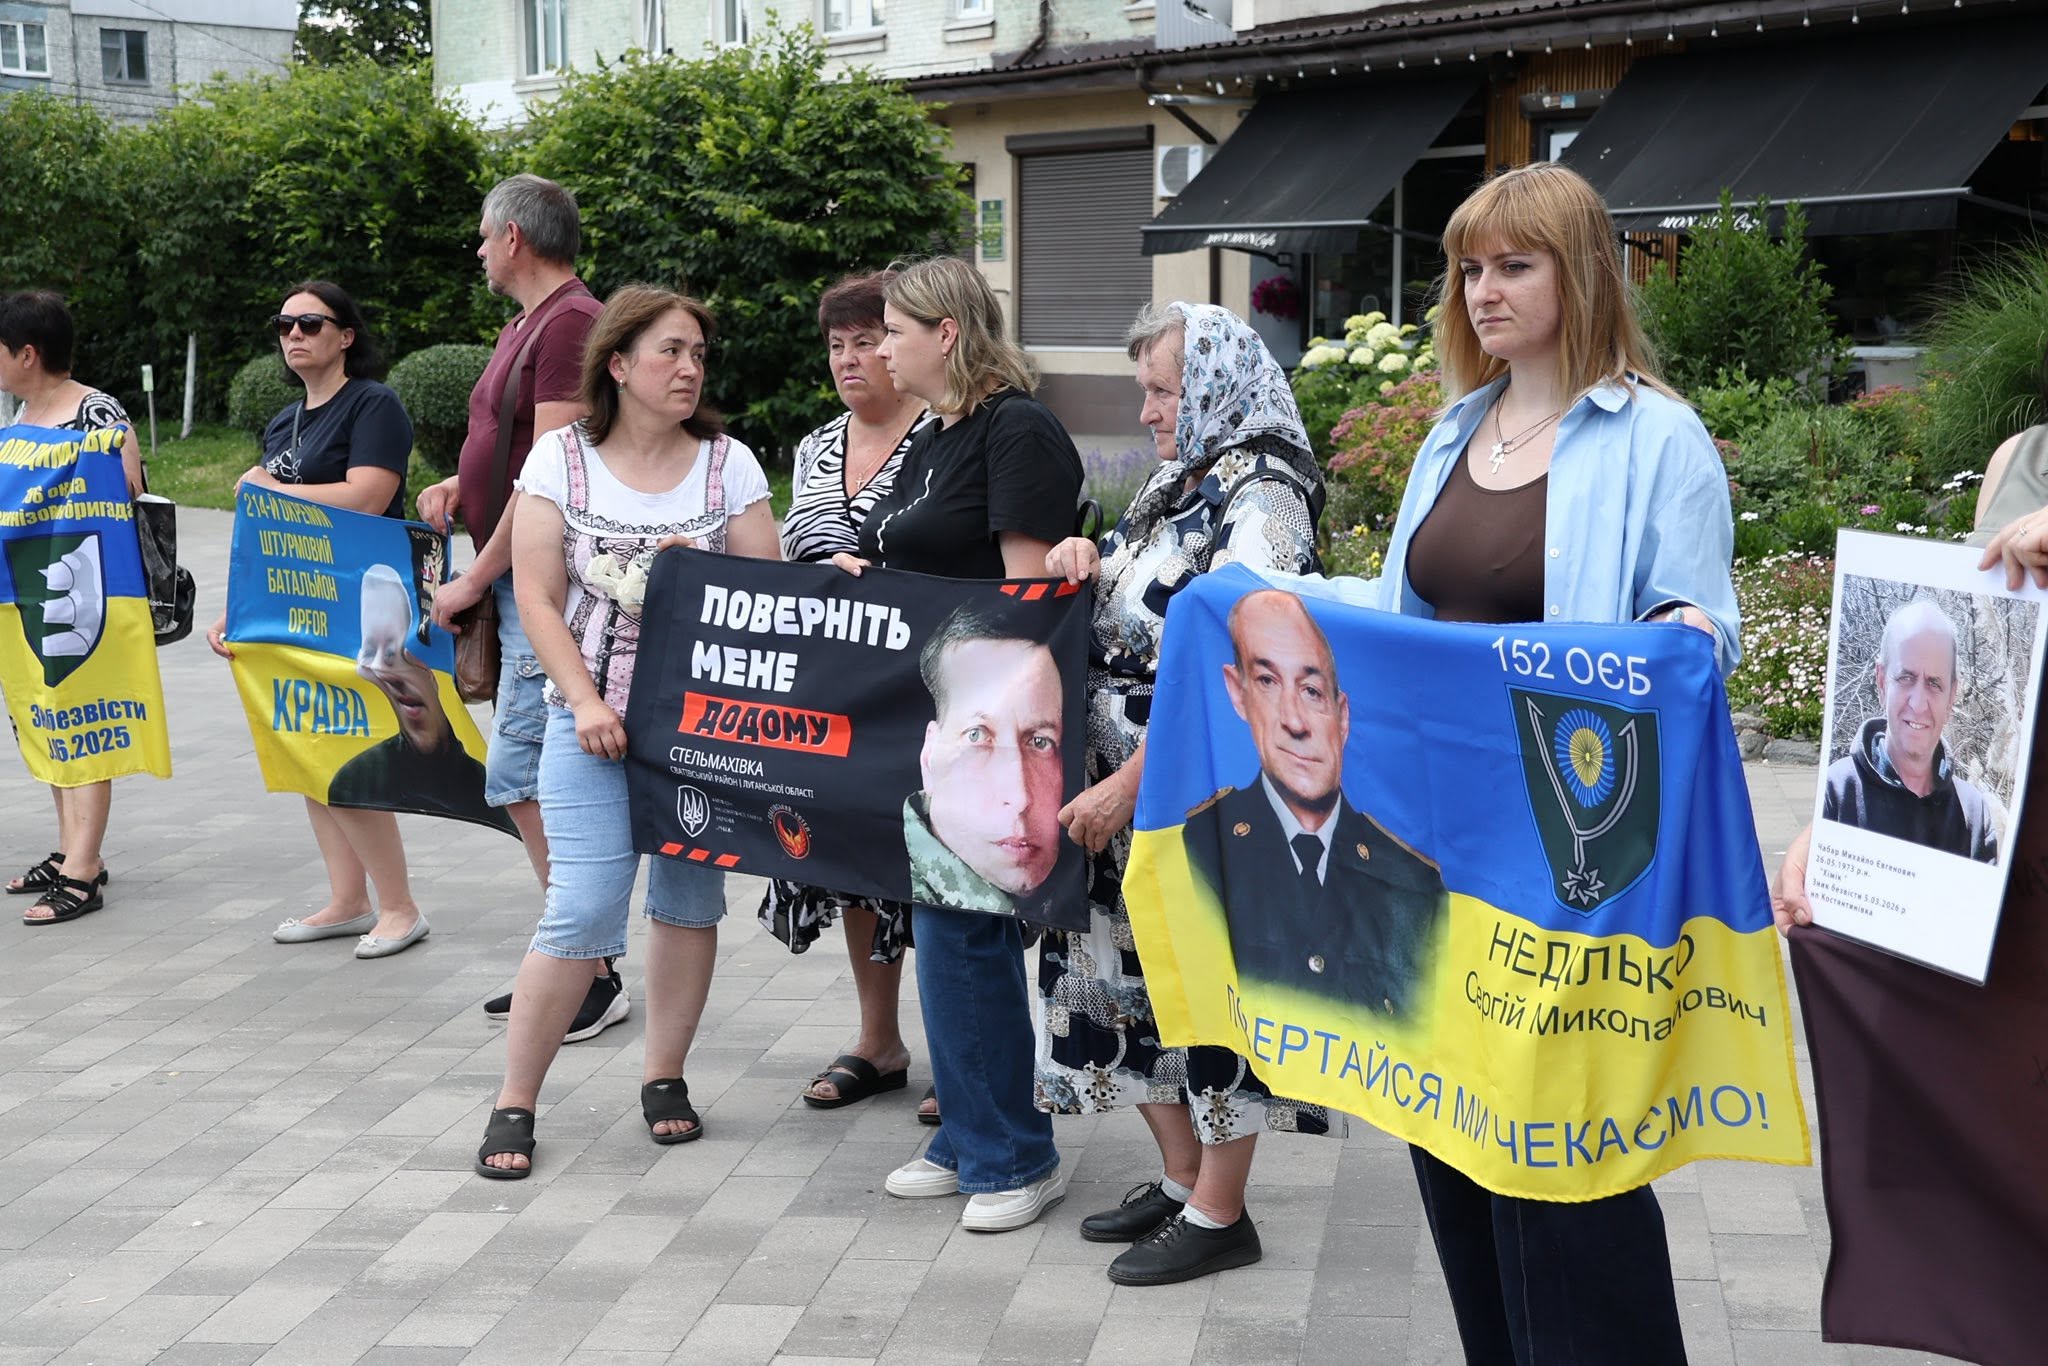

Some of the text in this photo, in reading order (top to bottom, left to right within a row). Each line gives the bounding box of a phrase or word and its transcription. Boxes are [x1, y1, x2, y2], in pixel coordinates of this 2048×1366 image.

[243, 492, 281, 521] 214-Й
[260, 530, 333, 564] ШТУРМОВИЙ
[267, 567, 339, 602] БАТАЛЬЙОН
[287, 606, 329, 638] OPFOR
[700, 584, 912, 650] ПОВЕРНІТЬ
[690, 640, 798, 693] МЕНЕ
[1491, 636, 1652, 696] 152 ОЄБ
[273, 677, 370, 738] КРАВА
[694, 700, 831, 747] ДОДОМУ
[669, 746, 764, 777] СТЕЛЬМАХІВКА
[714, 774, 739, 786] РАЙОН
[743, 779, 785, 794] ЛУГАНСЬКОЇ
[785, 786, 815, 799] ОБЛАСТІ
[1815, 854, 1855, 873] 26.05.1973
[1841, 849, 1874, 867] Михайло
[1876, 859, 1917, 878] Євгенович
[1812, 878, 1829, 890] Зник
[1830, 883, 1862, 900] безвісти
[1821, 893, 1873, 917] Костянтинівка
[1488, 921, 1695, 994] НЕДІЛЬКО
[1465, 970, 1526, 1031] Сергій
[1453, 1085, 1489, 1151] МИ
[1494, 1084, 1769, 1168] ЧЕКАЄМО!
